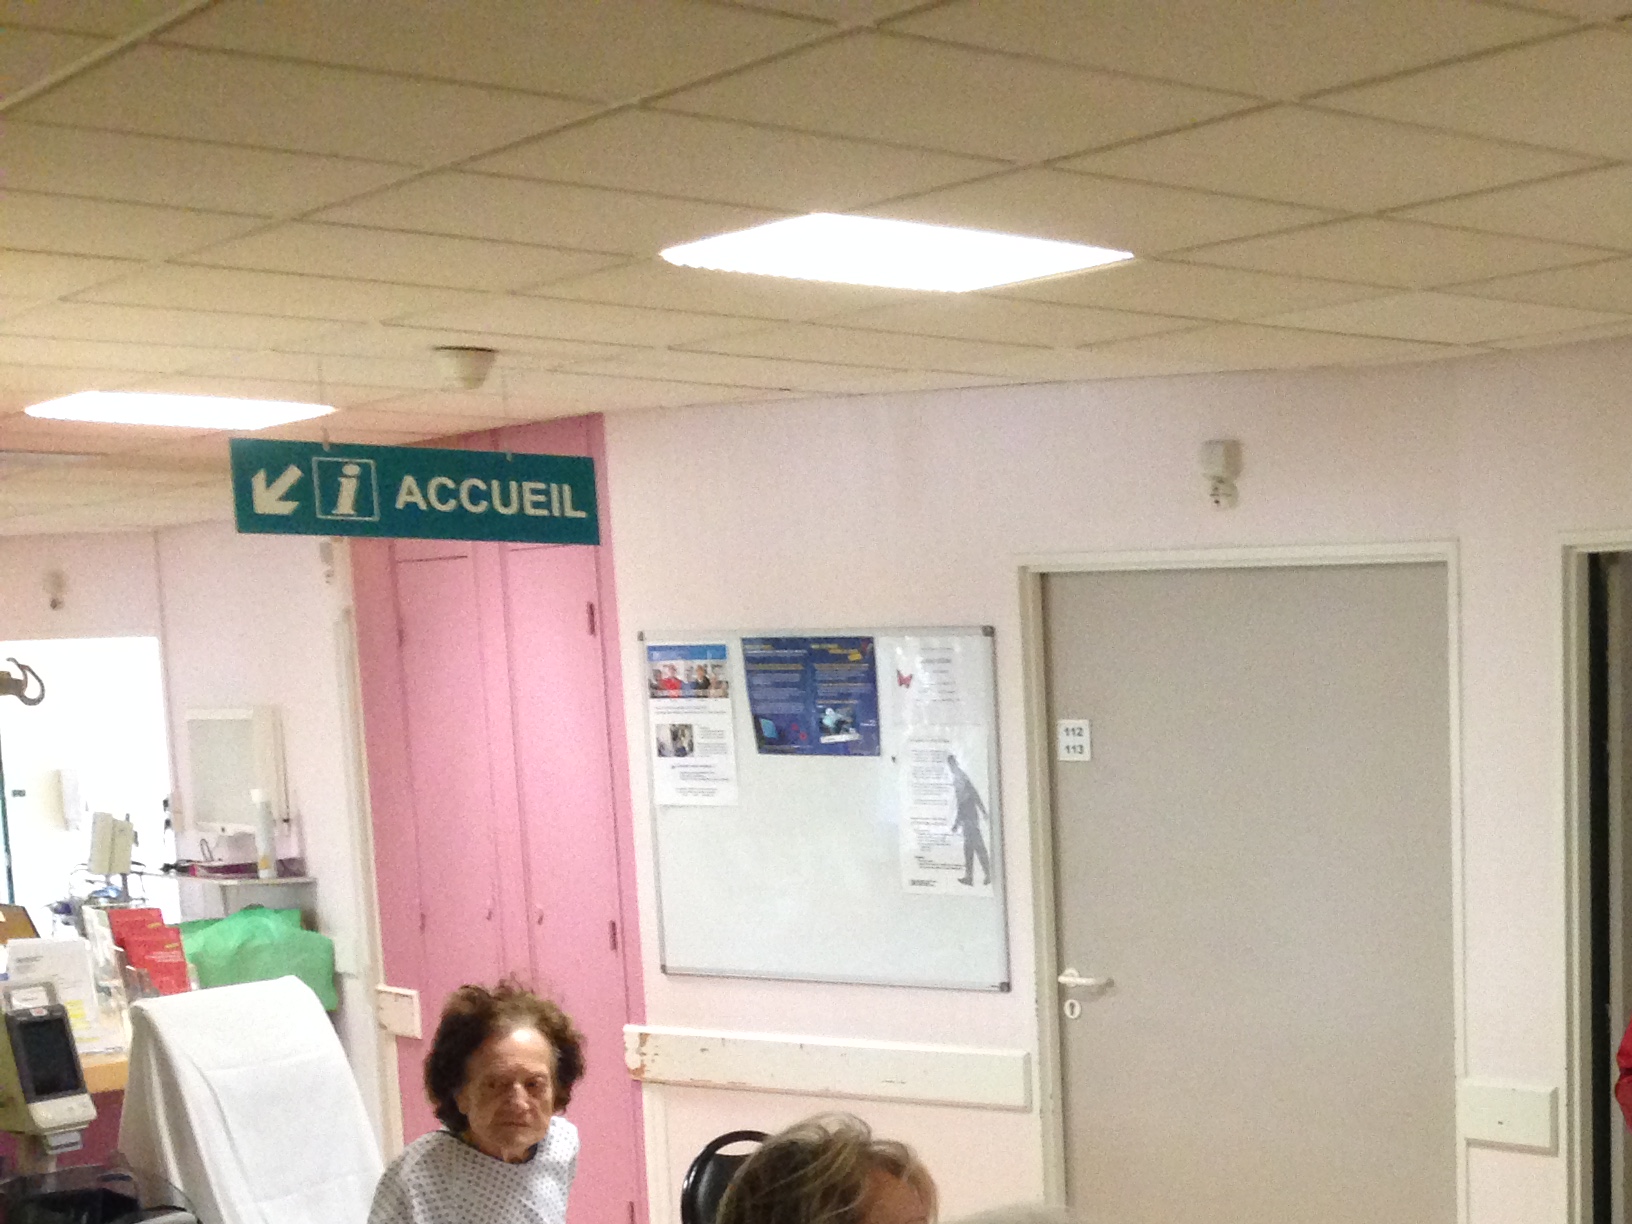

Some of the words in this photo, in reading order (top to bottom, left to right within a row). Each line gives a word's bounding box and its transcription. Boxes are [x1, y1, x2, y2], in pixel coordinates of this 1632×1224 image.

[332, 464, 361, 516] i
[395, 475, 587, 519] ACCUEIL
[1063, 726, 1084, 737] 112
[1065, 744, 1084, 755] 113
